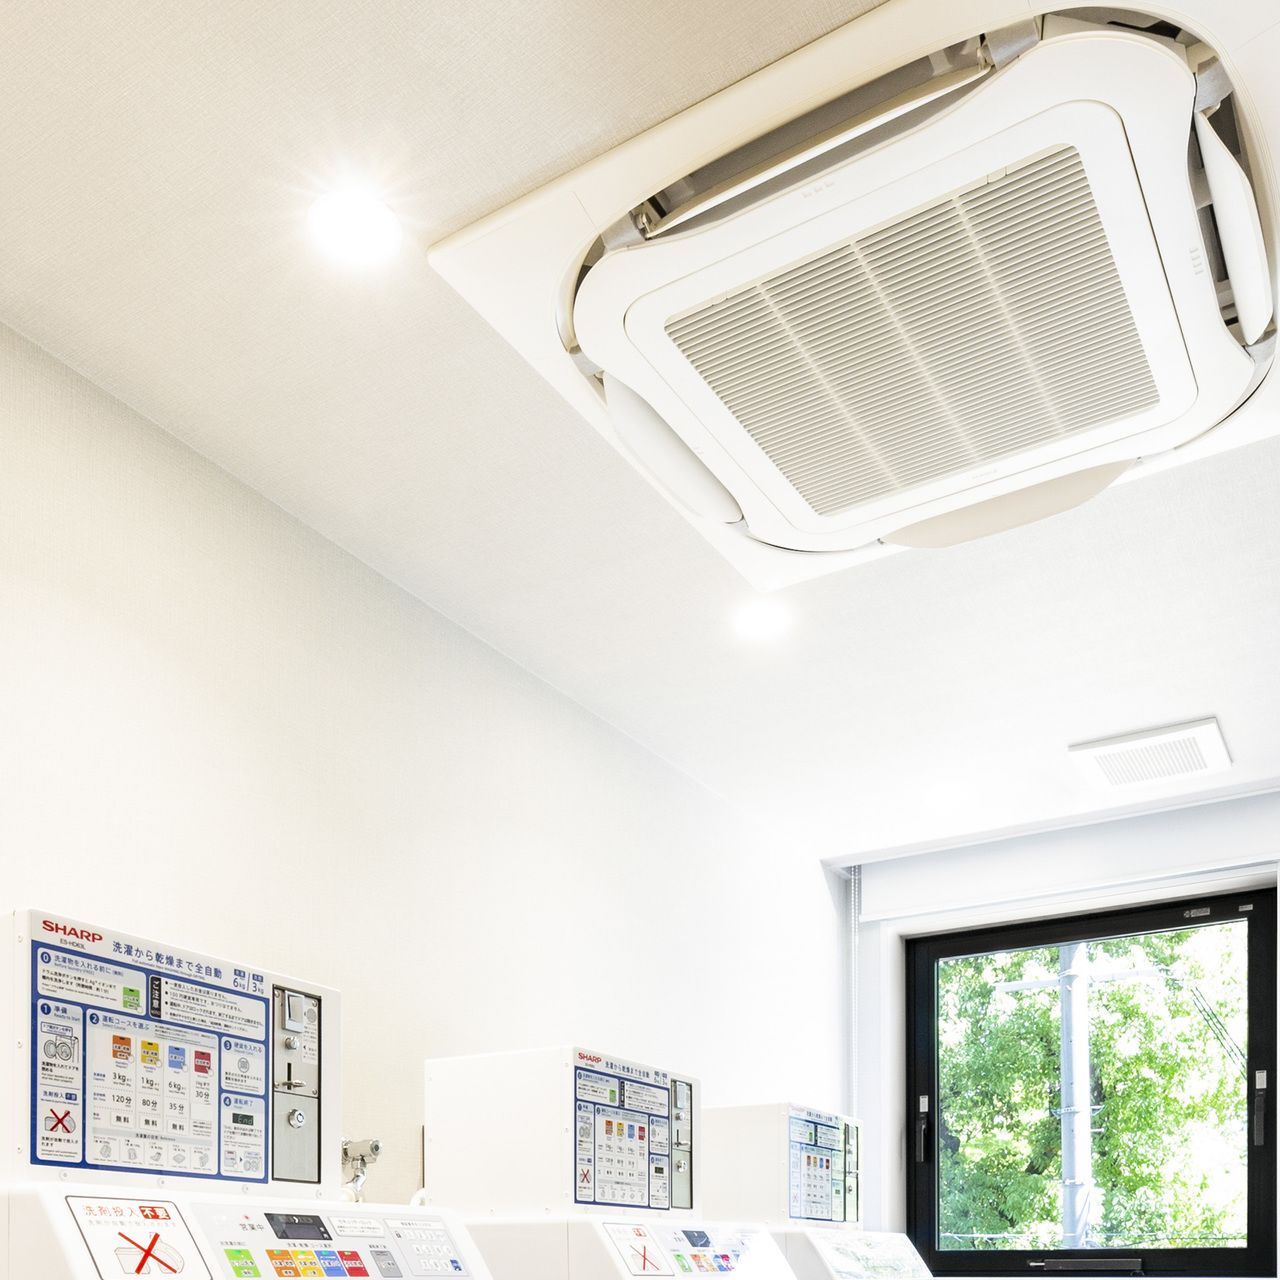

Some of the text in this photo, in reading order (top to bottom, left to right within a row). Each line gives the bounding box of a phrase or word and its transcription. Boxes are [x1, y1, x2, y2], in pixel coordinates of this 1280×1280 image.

[42, 919, 103, 943] SHARP
[112, 940, 222, 979] 洗濯から乾燥まで全自動
[102, 1014, 150, 1030] 運転コースを選ぶ
[578, 1052, 602, 1064] SHARP
[112, 1072, 126, 1082] 3kg
[142, 1076, 154, 1086] 1kg
[168, 1081, 181, 1091] 6kg
[112, 1094, 132, 1104] 120分
[196, 1090, 210, 1100] 30分
[142, 1100, 158, 1108] 80分
[169, 1102, 184, 1112] 35分
[84, 1206, 140, 1217] 洗剤投入
[240, 1223, 264, 1232] 営業中
